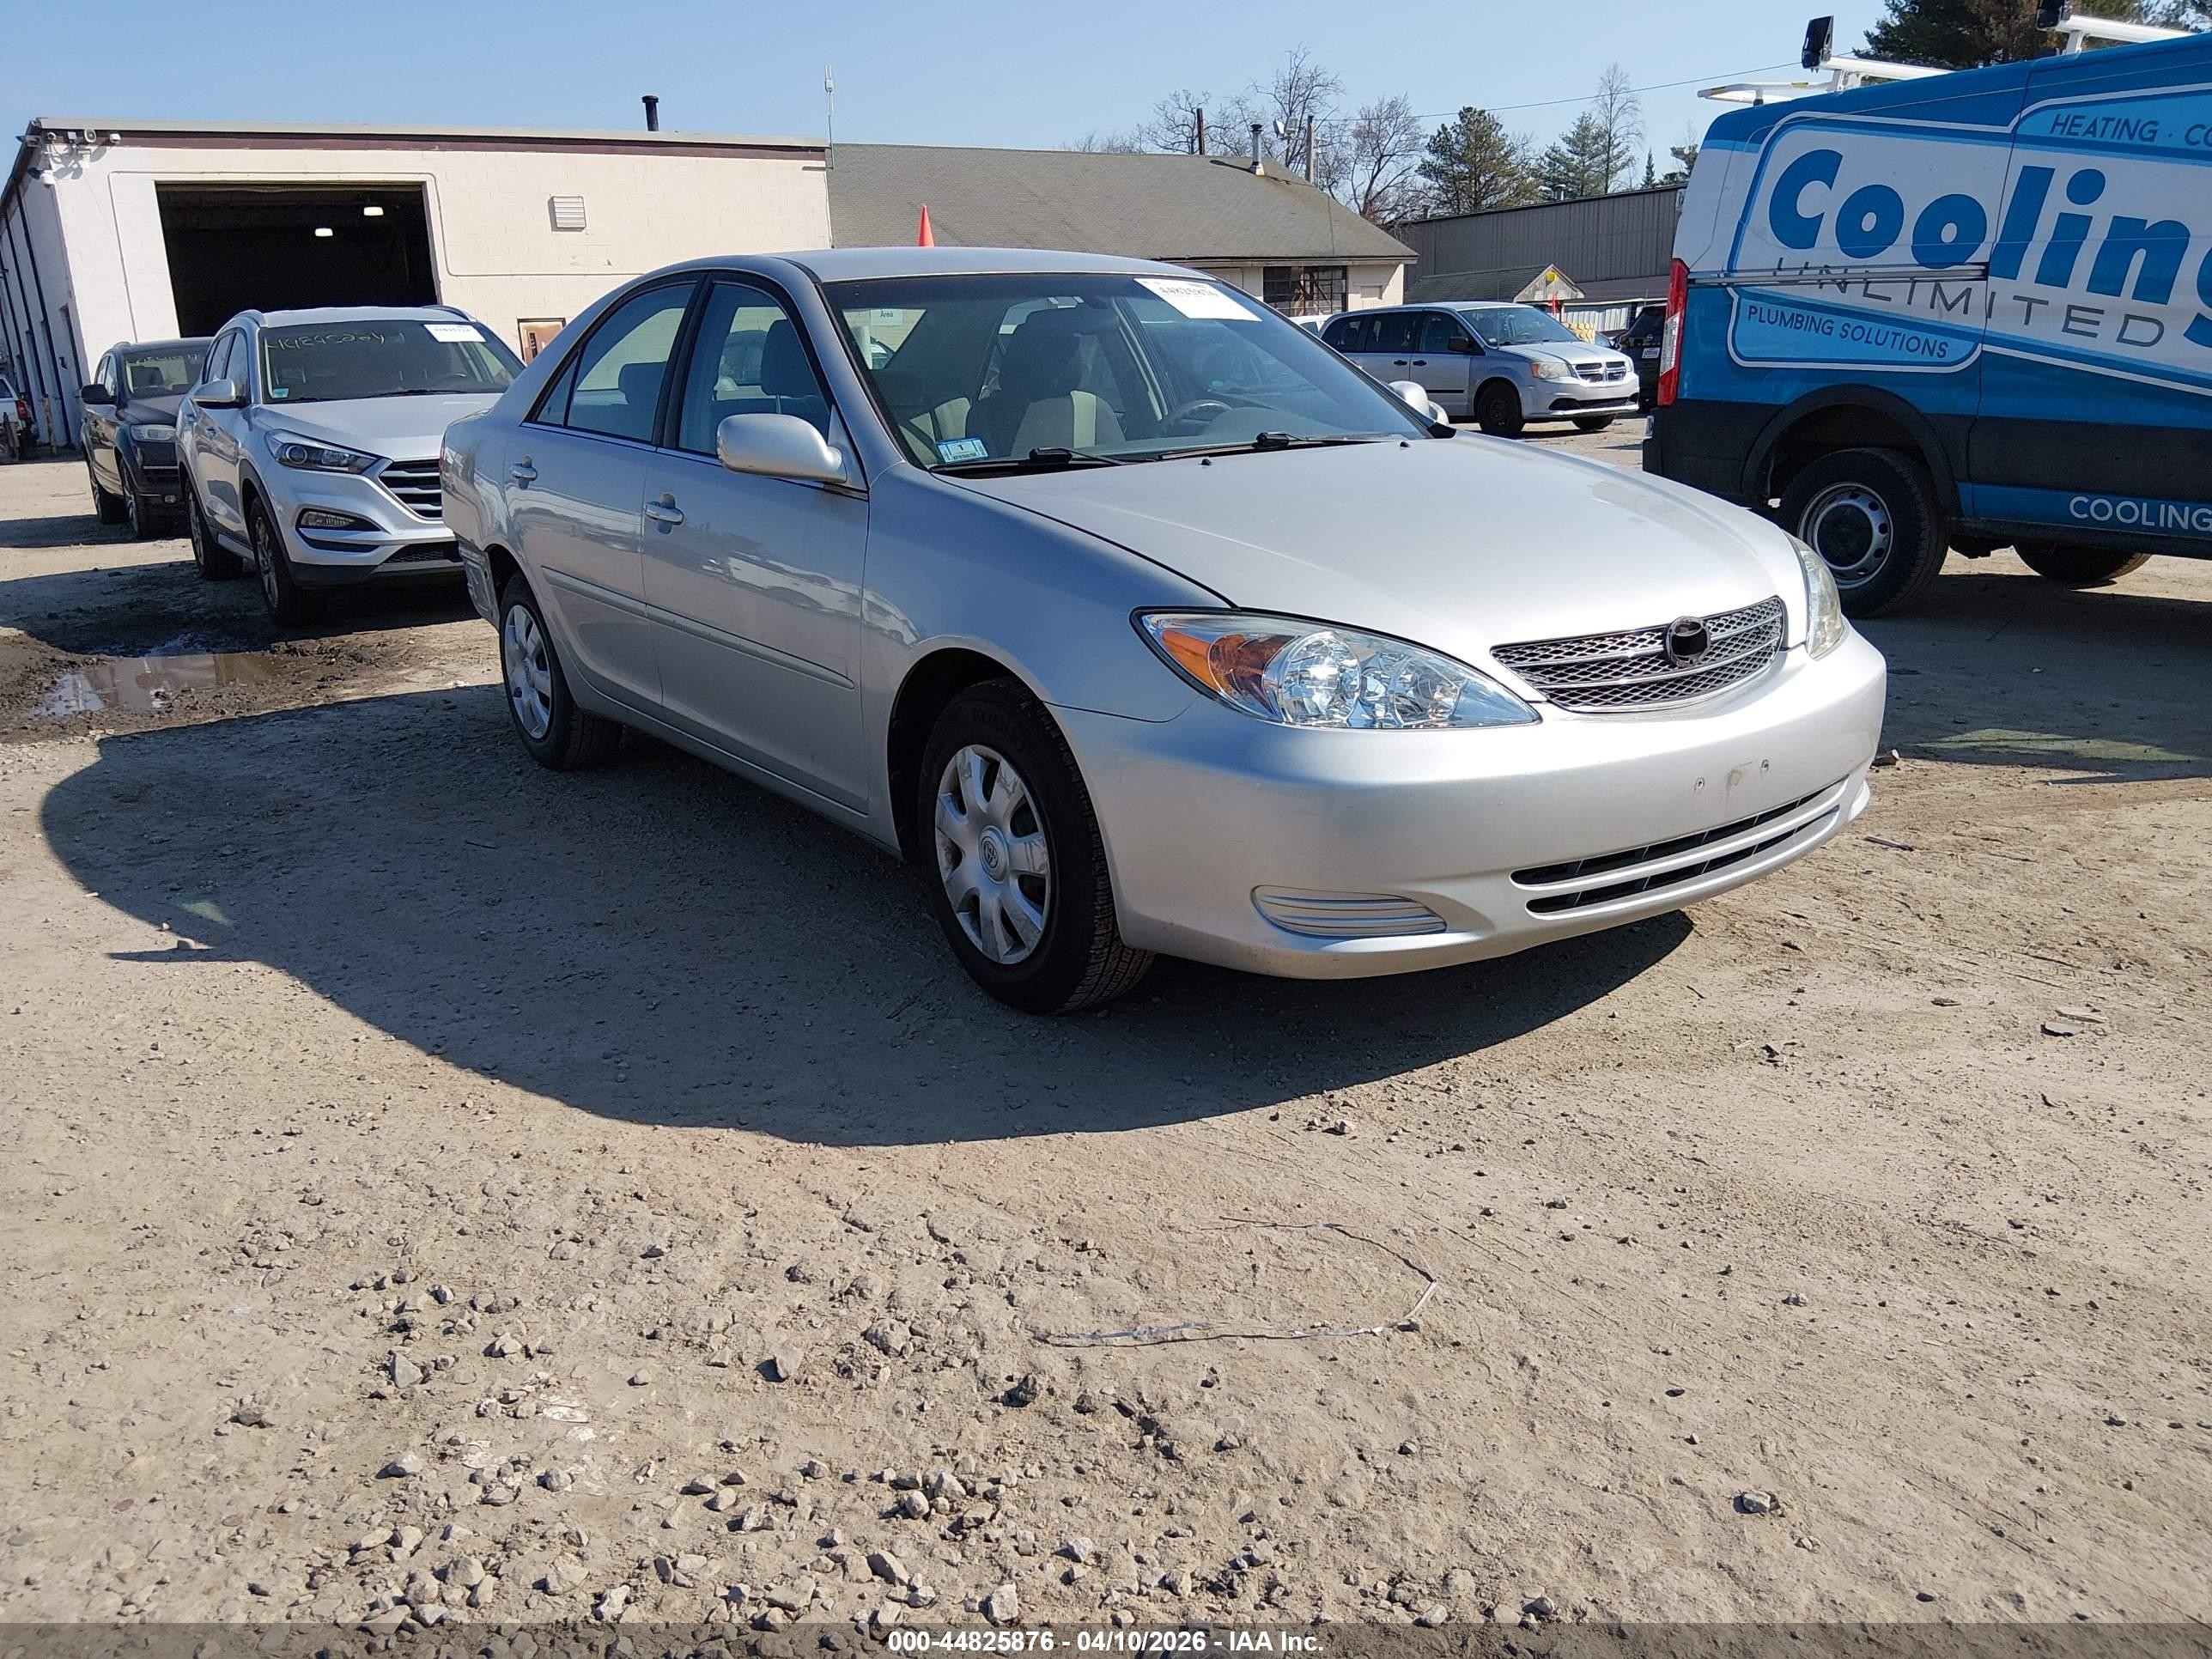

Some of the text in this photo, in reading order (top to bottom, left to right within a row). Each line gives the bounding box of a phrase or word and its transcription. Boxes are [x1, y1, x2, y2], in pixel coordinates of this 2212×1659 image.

[2050, 113, 2159, 143] HEATING
[1747, 305, 1948, 359] PLUMBING SOLUTIONS
[2069, 495, 2212, 532] COOLING
